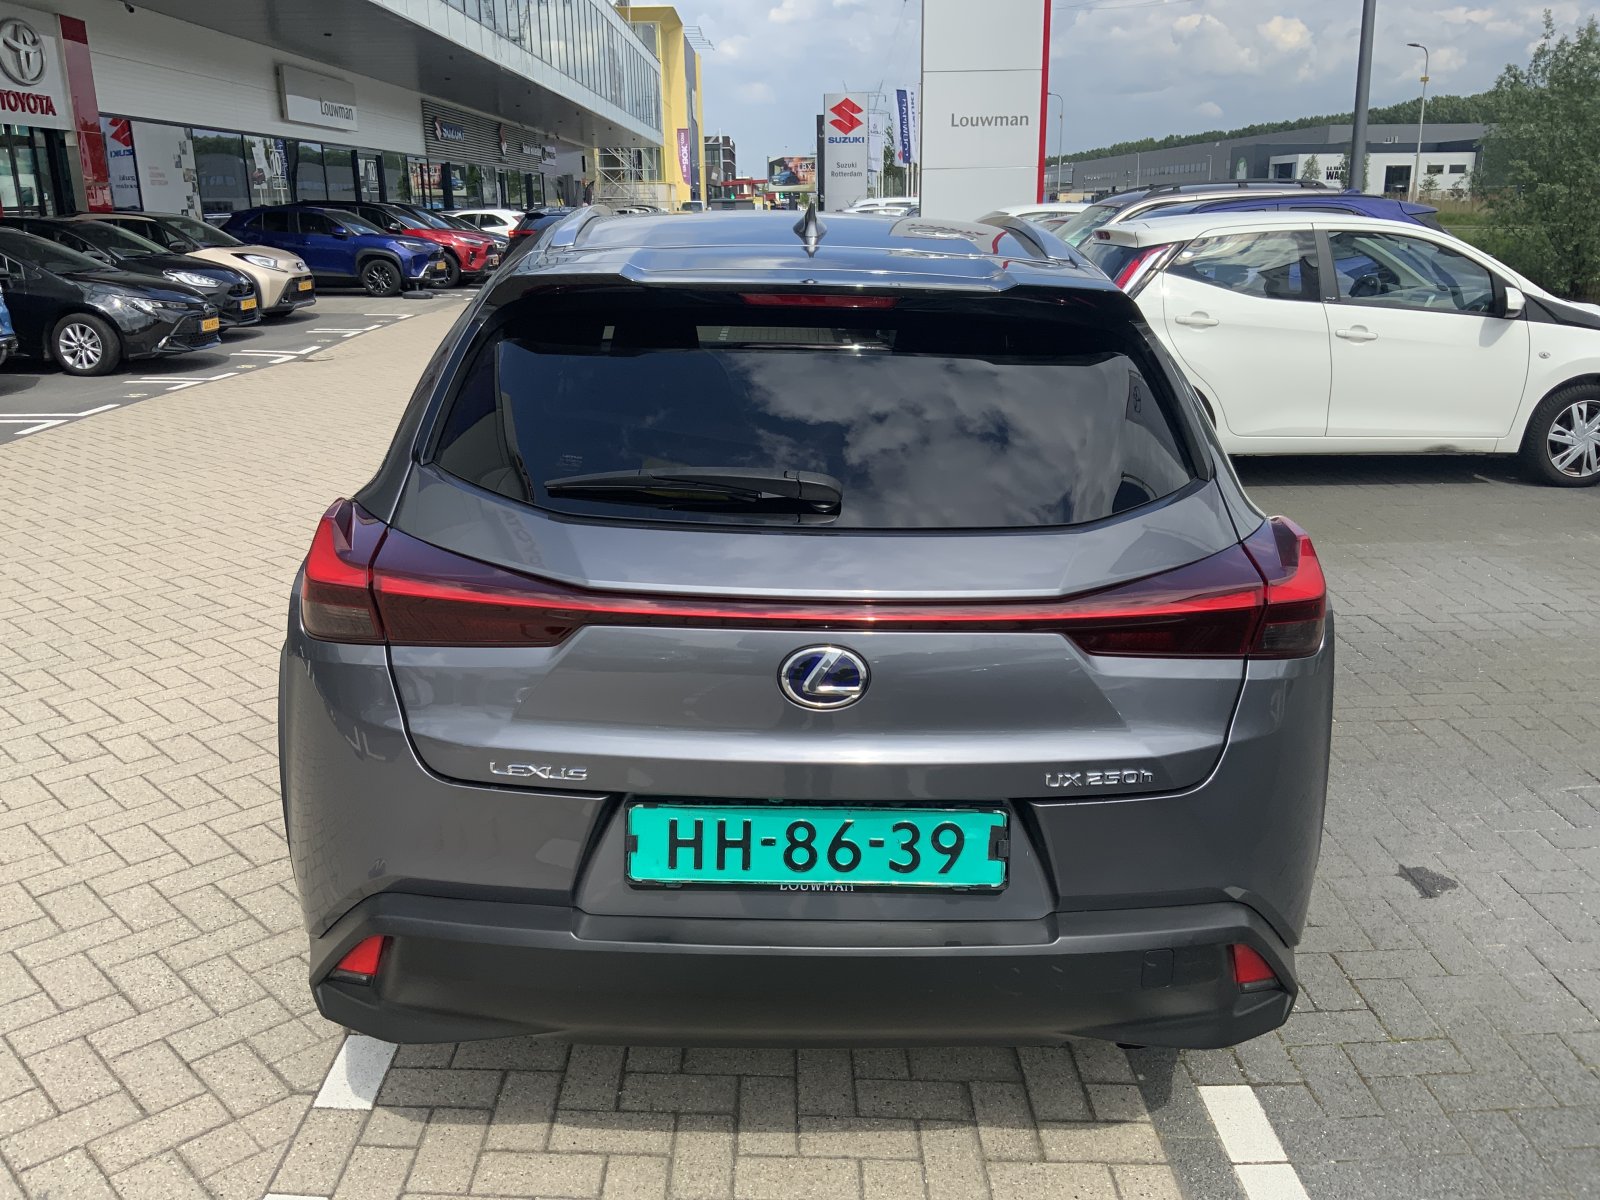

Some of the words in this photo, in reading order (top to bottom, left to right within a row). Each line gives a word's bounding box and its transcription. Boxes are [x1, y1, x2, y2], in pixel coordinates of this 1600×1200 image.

[0, 89, 57, 116] TOYOTA
[319, 97, 354, 120] Louwman
[951, 112, 1029, 127] Louwman
[828, 136, 865, 144] SUZUKI
[830, 170, 863, 178] Rotterdam
[836, 161, 857, 169] Suzuki
[489, 762, 588, 781] LEXUS
[1045, 773, 1082, 788] UX
[1086, 769, 1153, 786] 250h
[668, 817, 965, 874] HH-86-39
